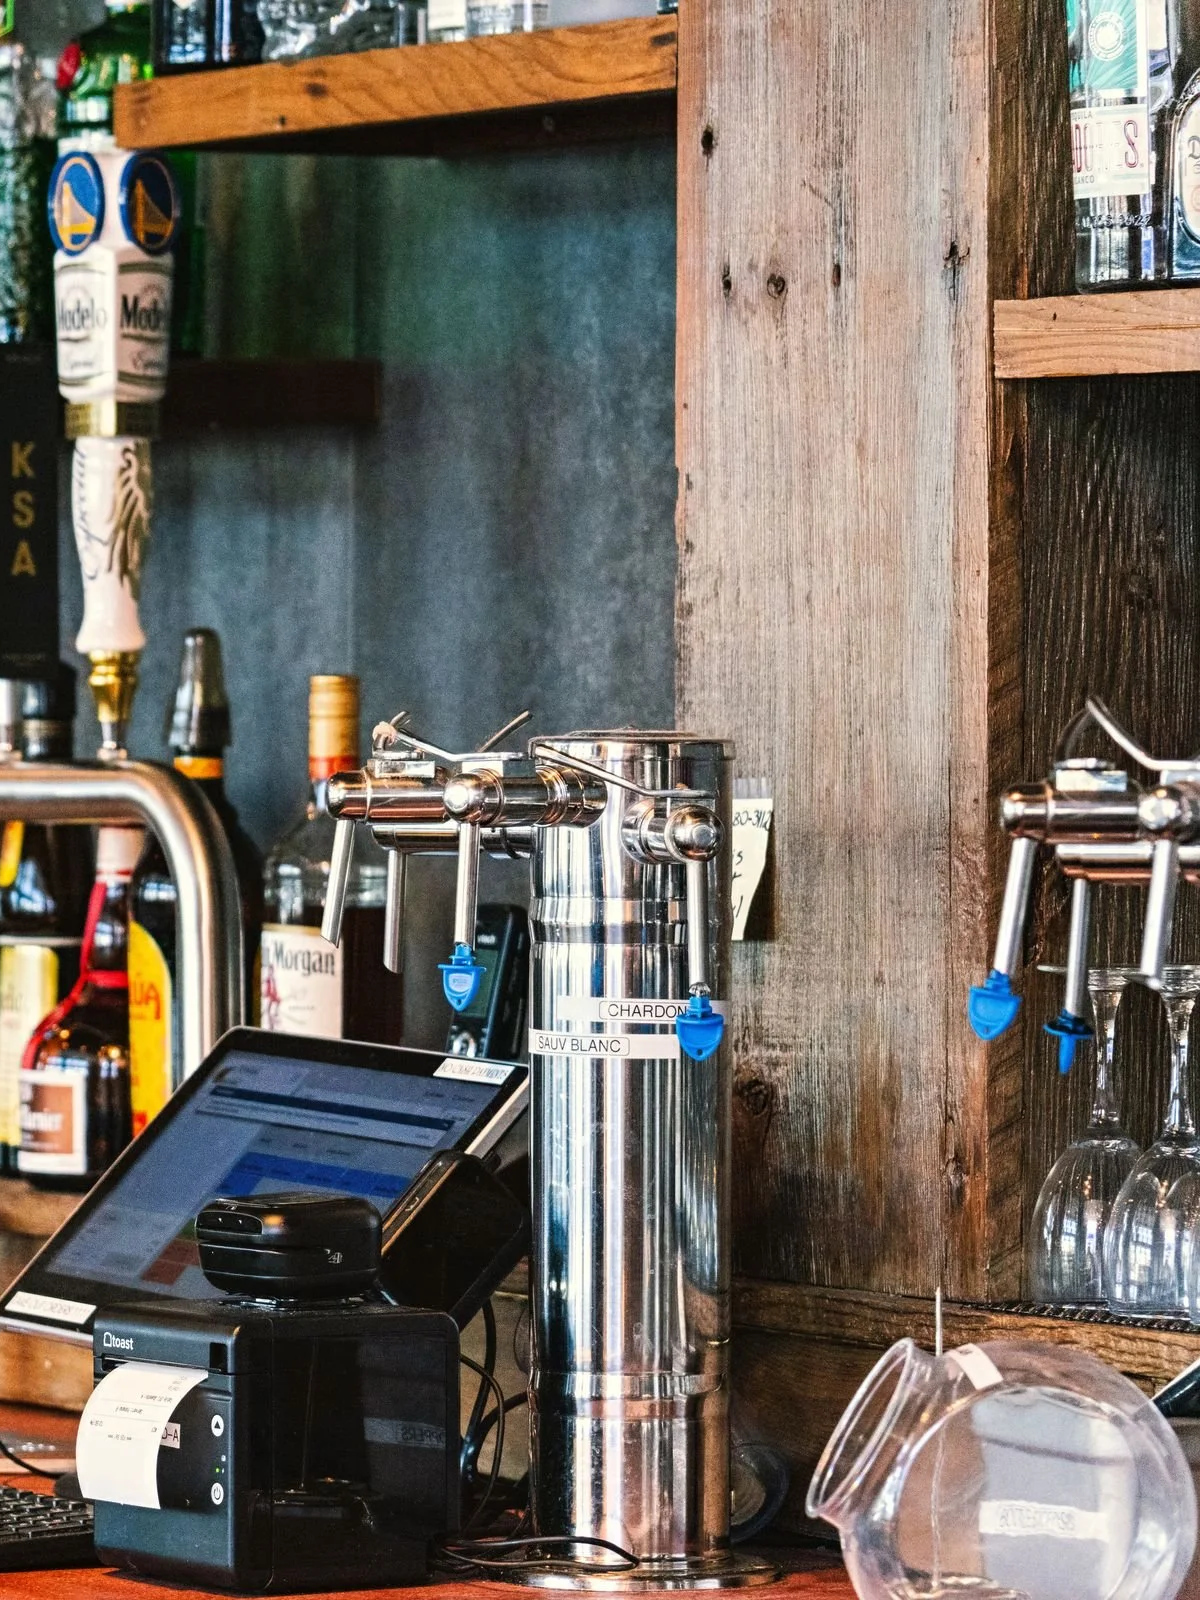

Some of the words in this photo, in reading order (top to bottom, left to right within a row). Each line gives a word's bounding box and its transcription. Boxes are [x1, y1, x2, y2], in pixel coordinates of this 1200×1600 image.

[11, 440, 37, 577] KSA
[274, 941, 336, 977] Morgan
[538, 1035, 567, 1051] SAUV
[570, 1037, 622, 1054] BLANC
[111, 1334, 134, 1350] toast
